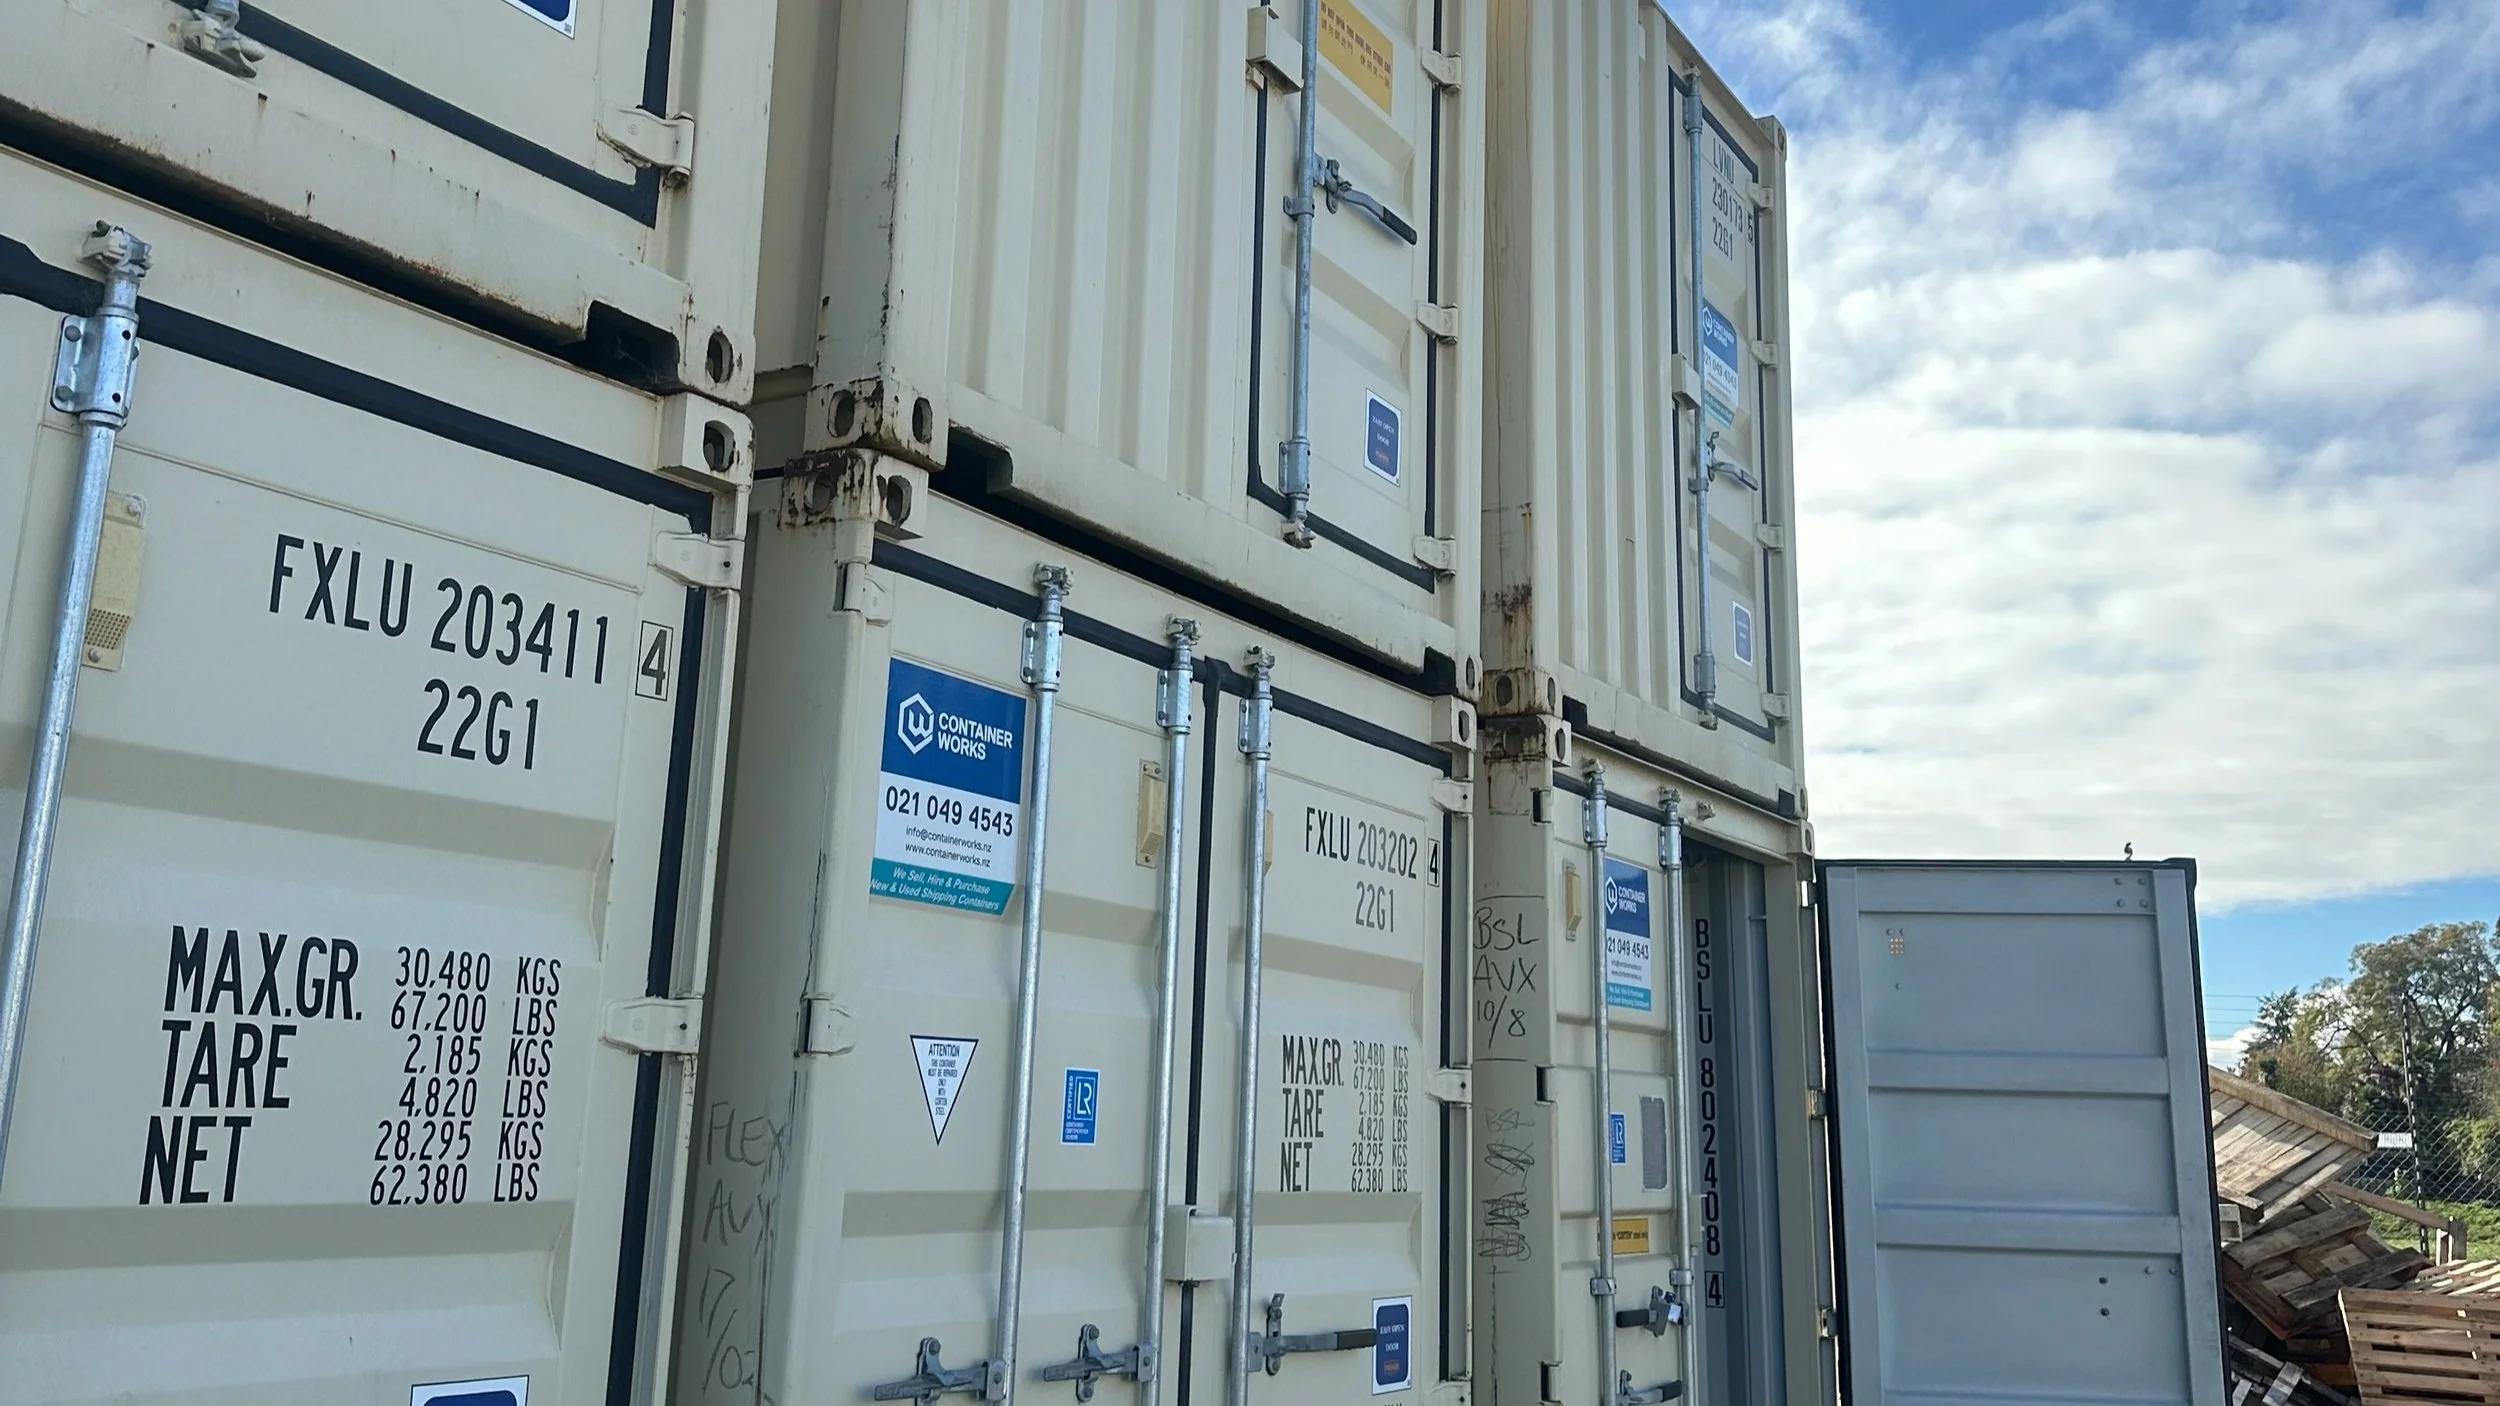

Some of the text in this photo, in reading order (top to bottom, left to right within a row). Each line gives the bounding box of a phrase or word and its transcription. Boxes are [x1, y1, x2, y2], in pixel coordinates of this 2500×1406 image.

[1712, 177, 1743, 233] 230173
[1712, 216, 1733, 261] 22G1
[268, 533, 669, 695] FXLU 203411 4
[416, 678, 539, 770] 22G1
[937, 731, 987, 761] WORKS
[938, 712, 1014, 750] CONTAINER
[886, 785, 1014, 837] 021 049 4543
[905, 825, 992, 853] info@containerworks.nz
[905, 844, 991, 868] www.containerworks.nz
[1305, 806, 1439, 884] FXLU 203202 4
[870, 879, 999, 911] New & Used Shipping Containers
[893, 867, 907, 879] We
[927, 870, 945, 887] Hire
[945, 877, 953, 888] &
[954, 879, 991, 896] Purchase
[1618, 886, 1646, 904] CONTAINER
[1355, 880, 1394, 933] 22G1
[1473, 906, 1541, 950] BSL
[1618, 899, 1637, 913] WORKS
[1617, 938, 1631, 957] 049
[1632, 942, 1649, 961] 4543
[164, 925, 562, 1020] MAX.GR. 30,480 KGS
[1694, 918, 1714, 1044] BSLU
[390, 990, 557, 1037] 67,200 LBS
[1477, 995, 1526, 1049] 10/8
[161, 1020, 553, 1108] TARE 2,185 KGS
[928, 1043, 961, 1057] ATTENTION
[1282, 1034, 1344, 1087] MAX.GR.
[1392, 1044, 1409, 1070] KGS
[399, 1076, 549, 1118] 4,820 LBS
[1066, 1075, 1074, 1119] CERTIFIED
[1392, 1069, 1409, 1094] LBS
[1282, 1087, 1324, 1138] TARE
[1392, 1094, 1408, 1118] KGS
[1391, 1117, 1408, 1143] LBS
[139, 1115, 544, 1205] NET 28,295 KGS
[1280, 1141, 1313, 1193] NET
[1391, 1143, 1408, 1168] KGS
[1700, 1057, 1721, 1257] 802408
[369, 1163, 540, 1206] 62,380 LBS
[1391, 1168, 1408, 1193] LBS
[1708, 1272, 1723, 1306] 4
